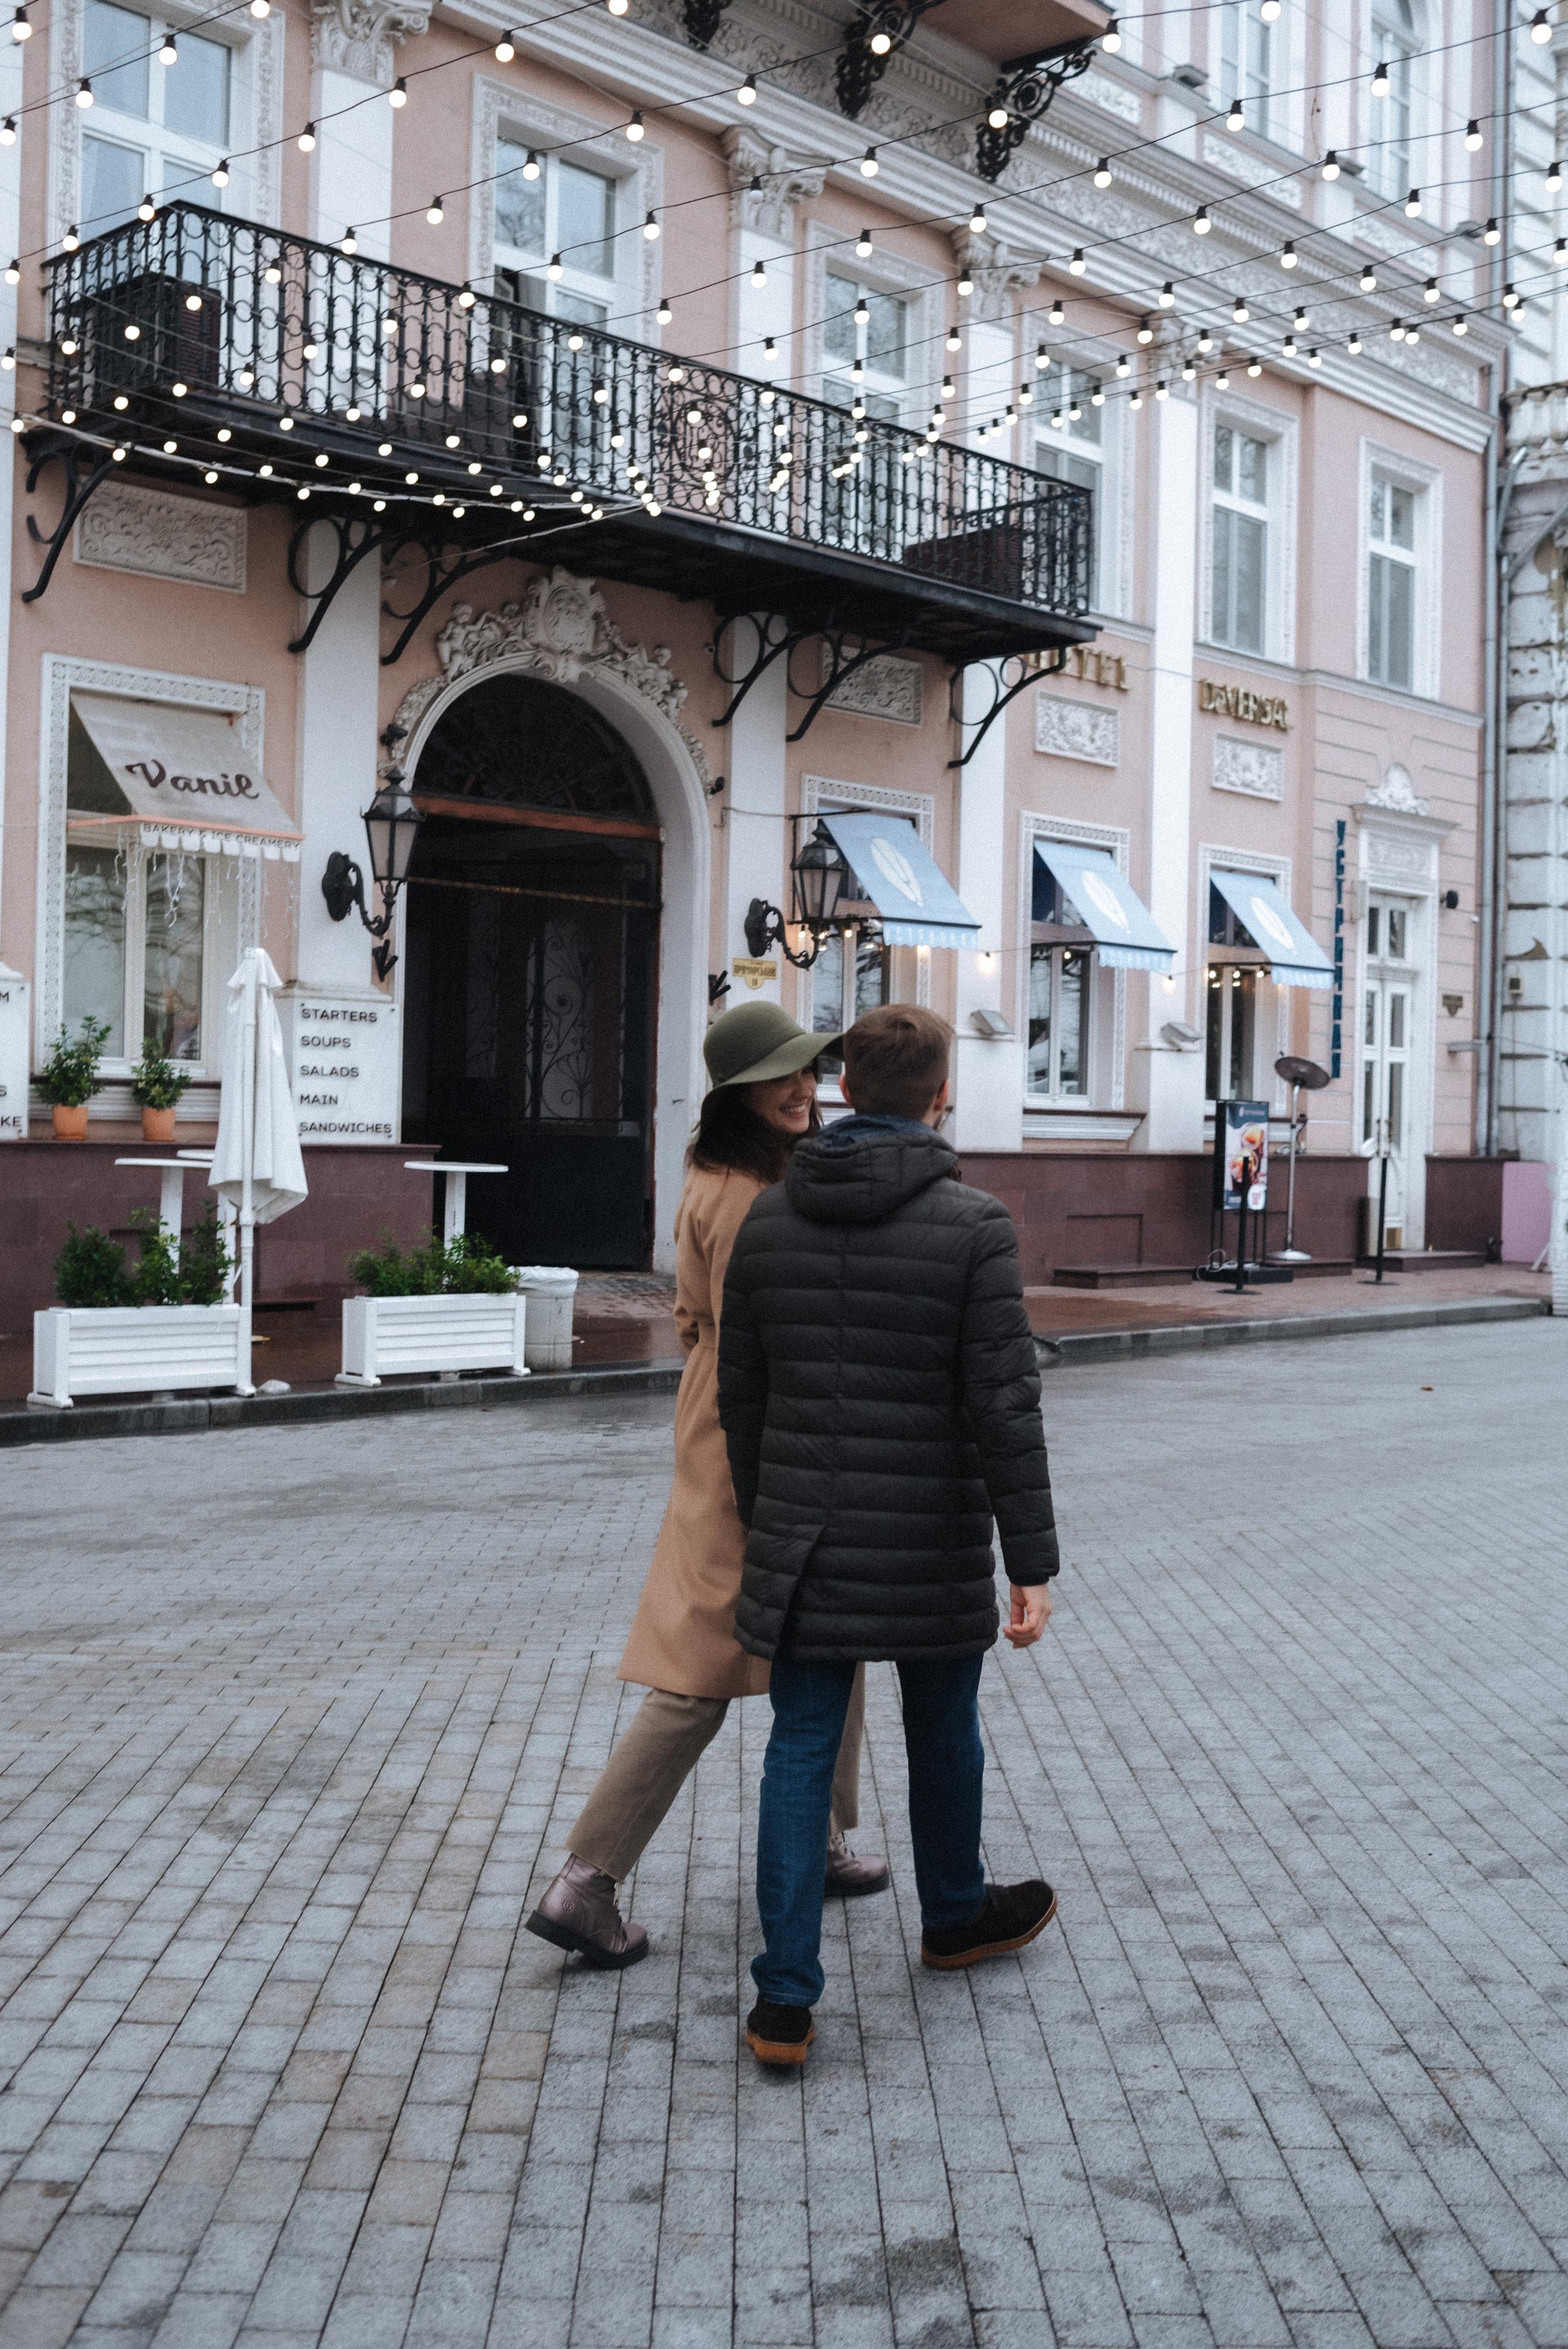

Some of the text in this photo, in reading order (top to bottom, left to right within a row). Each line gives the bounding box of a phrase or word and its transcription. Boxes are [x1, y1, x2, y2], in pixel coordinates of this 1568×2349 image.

[125, 759, 259, 799] Vanil
[143, 823, 194, 835] BAKERY
[302, 1008, 377, 1023] STARTERS
[301, 1035, 351, 1048] SOUPS
[301, 1065, 360, 1078] SALADS
[300, 1094, 338, 1105] MAIN
[300, 1122, 392, 1133] SANDWICHES
